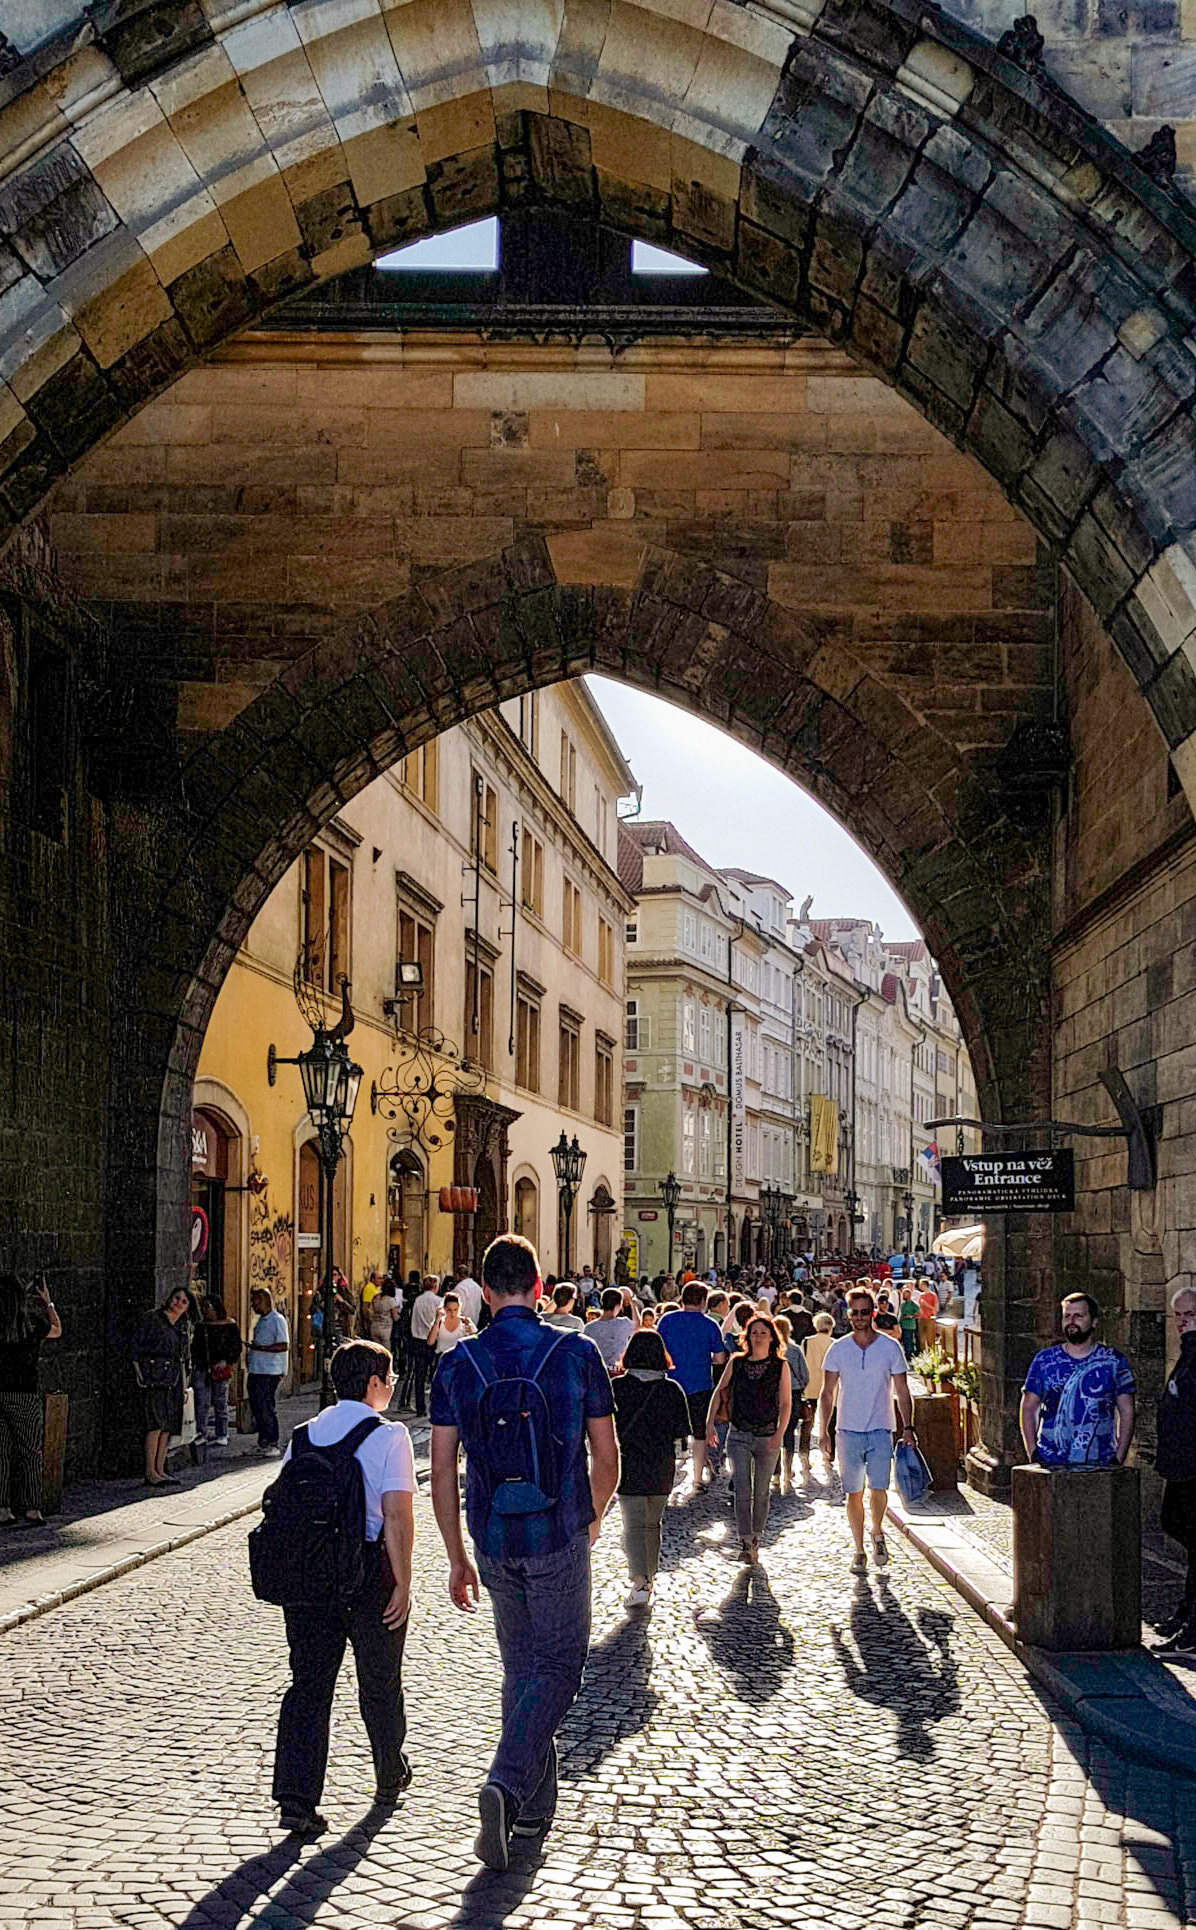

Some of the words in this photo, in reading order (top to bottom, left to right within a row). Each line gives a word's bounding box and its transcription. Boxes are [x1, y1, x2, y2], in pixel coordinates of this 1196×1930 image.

[735, 1031, 743, 1076] BALTHASAR
[735, 1078, 743, 1109] DOMUS
[735, 1122, 743, 1154] HOTEL
[735, 1156, 743, 1188] DESIGN
[963, 1159, 1004, 1174] Vstup
[1006, 1160, 1026, 1171] na
[1028, 1157, 1054, 1170] věž
[974, 1173, 1042, 1185] Entrance
